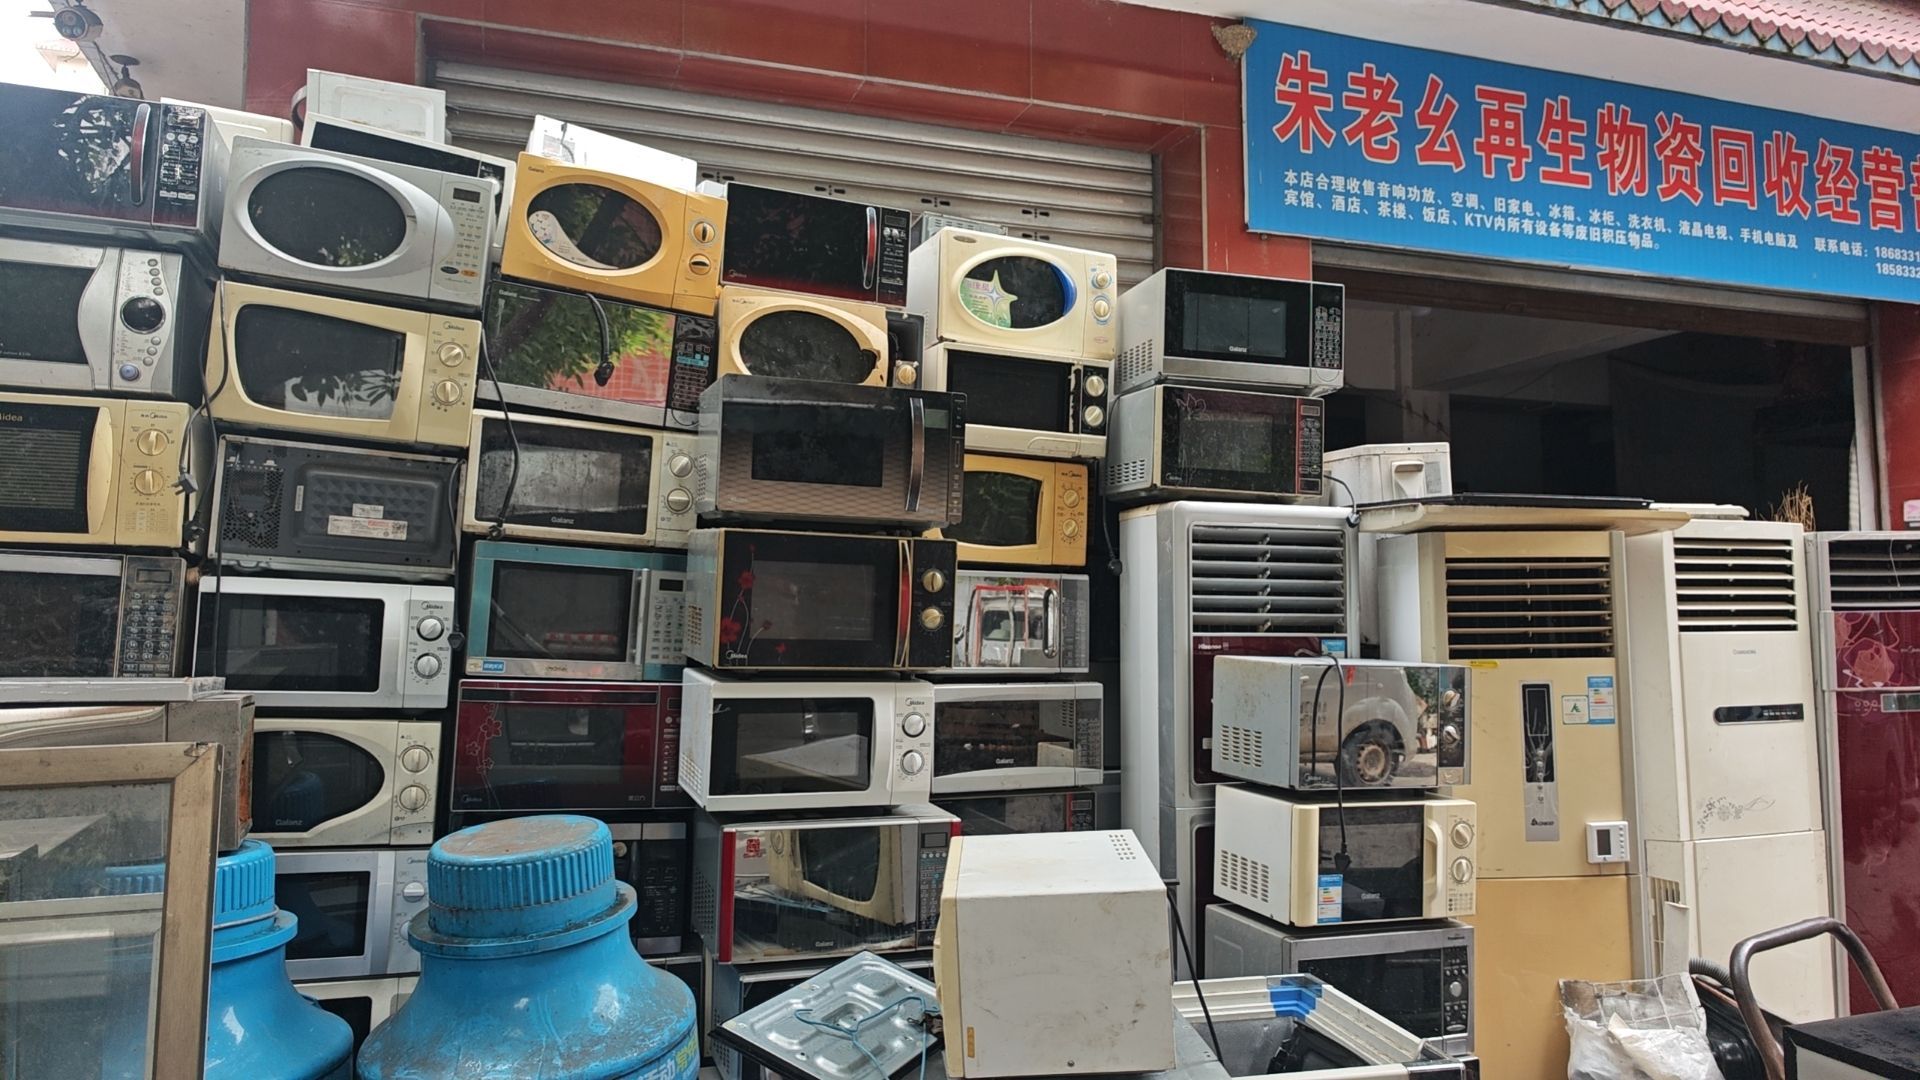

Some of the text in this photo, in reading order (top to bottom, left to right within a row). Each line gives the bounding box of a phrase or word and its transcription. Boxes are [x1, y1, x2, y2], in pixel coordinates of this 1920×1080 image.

[1273, 50, 1920, 233] 朱老幺再生物资回收经营
[551, 516, 575, 524] Galanz
[423, 602, 443, 610] Midea
